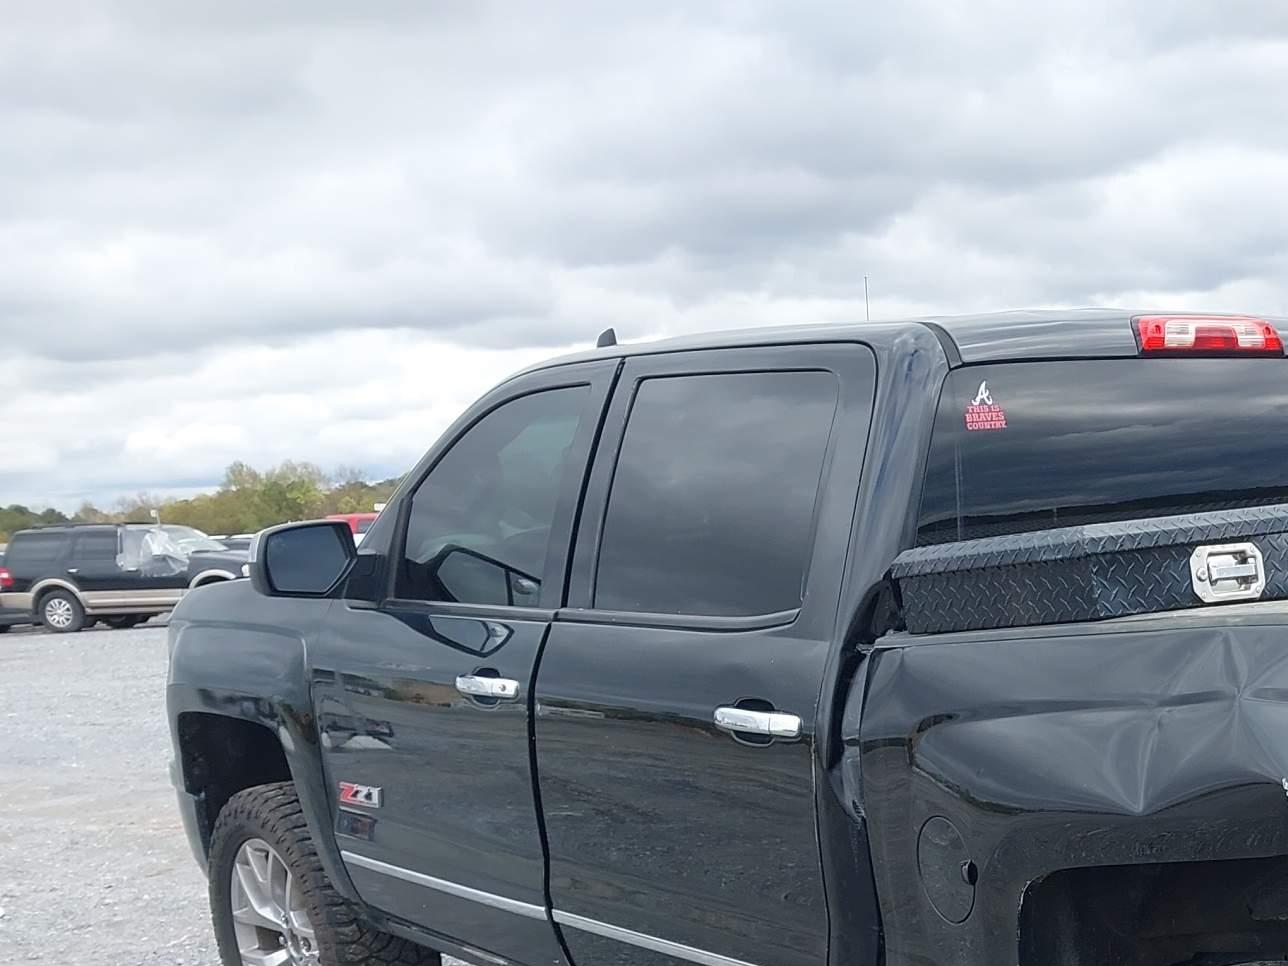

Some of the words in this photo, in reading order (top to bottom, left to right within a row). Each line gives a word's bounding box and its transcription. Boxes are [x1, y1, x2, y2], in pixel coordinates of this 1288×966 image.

[967, 404, 989, 413] THIS
[991, 404, 1000, 412] IS
[965, 411, 1005, 422] BRAVES
[967, 420, 1008, 430] COUNTRY
[338, 781, 382, 808] Z71
